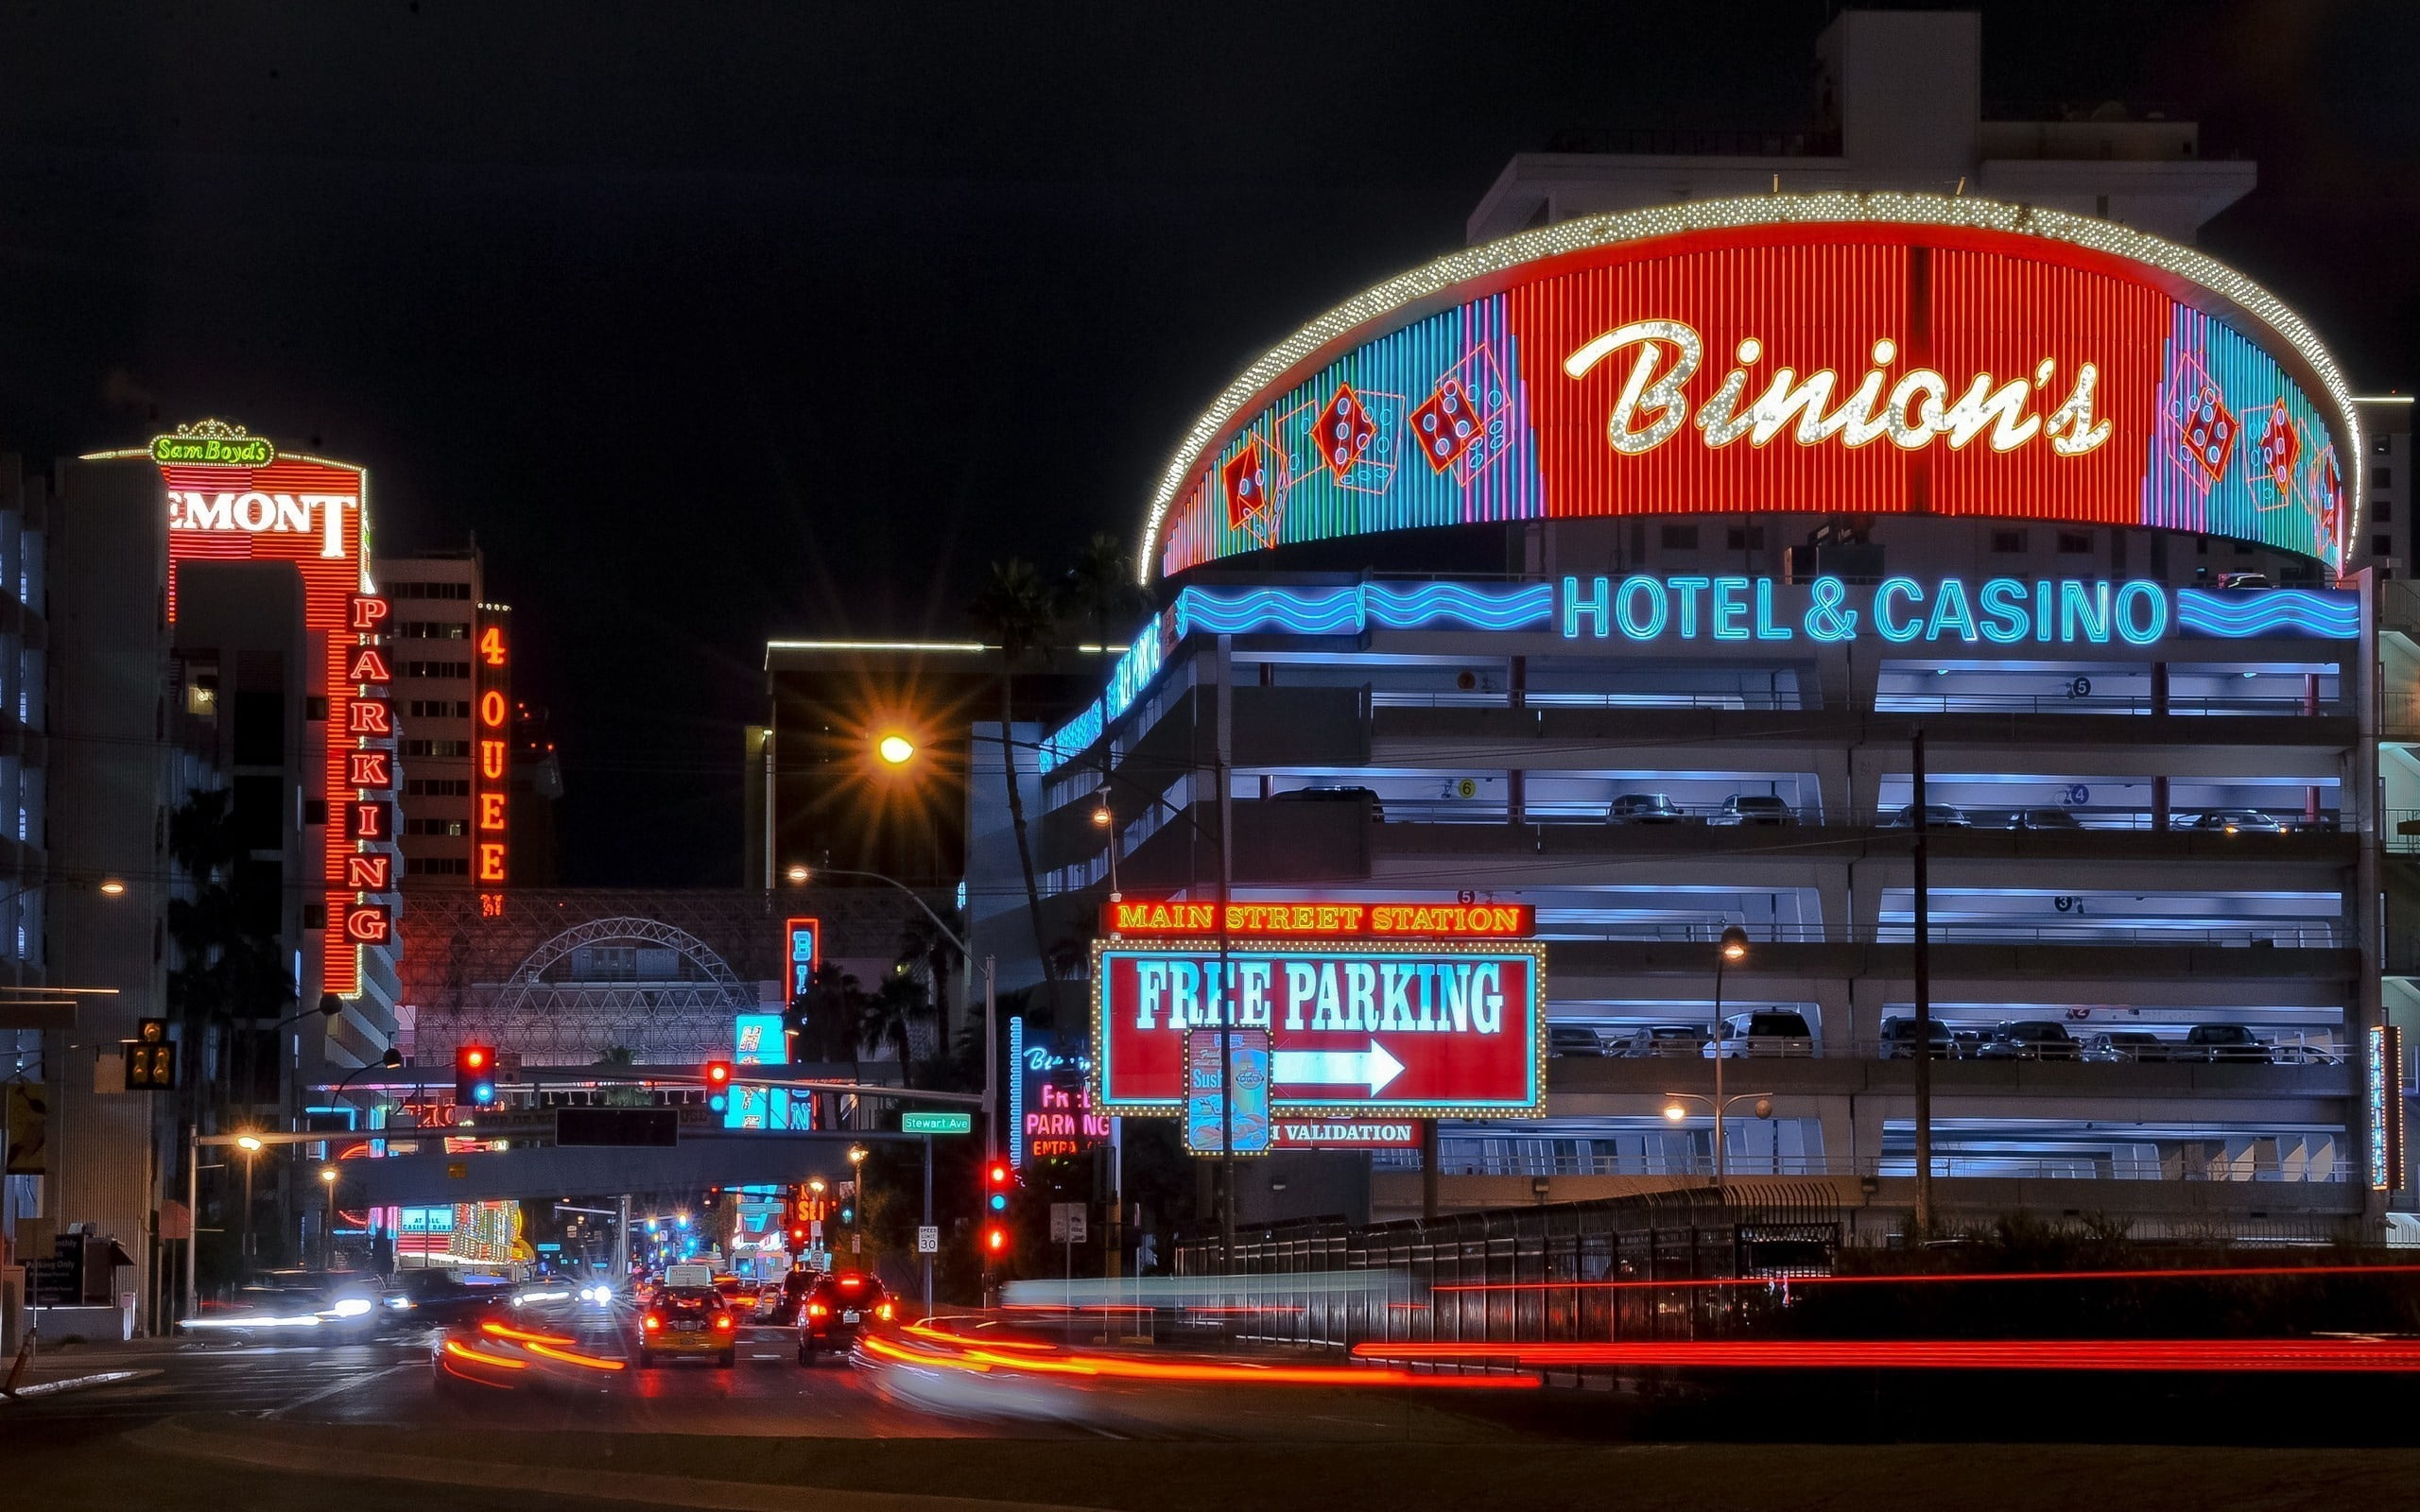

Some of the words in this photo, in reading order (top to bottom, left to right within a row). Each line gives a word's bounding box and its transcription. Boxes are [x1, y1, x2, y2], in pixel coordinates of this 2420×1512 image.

[1563, 318, 2114, 459] Binion's
[157, 438, 202, 460] Sam
[204, 440, 266, 463] Boyd's
[1563, 575, 1793, 642] HOTEL
[1804, 576, 1858, 643] &
[1873, 576, 2169, 645] CASINO
[480, 627, 506, 664] 4
[2077, 680, 2087, 693] 5
[347, 596, 389, 942] PARKING
[1462, 782, 1472, 795] 6
[2075, 788, 2085, 801] 4
[1461, 890, 1471, 904] 5
[2059, 896, 2068, 908] 3
[1117, 904, 1215, 929] MAIN
[1226, 905, 1362, 931] STREET
[1372, 906, 1520, 933] STATION
[1284, 960, 1504, 1034] PARKING
[905, 1118, 946, 1129] Stewart
[949, 1118, 968, 1129] Ave
[1284, 1125, 1412, 1142] VALIDATION
[921, 1239, 936, 1249] 30
